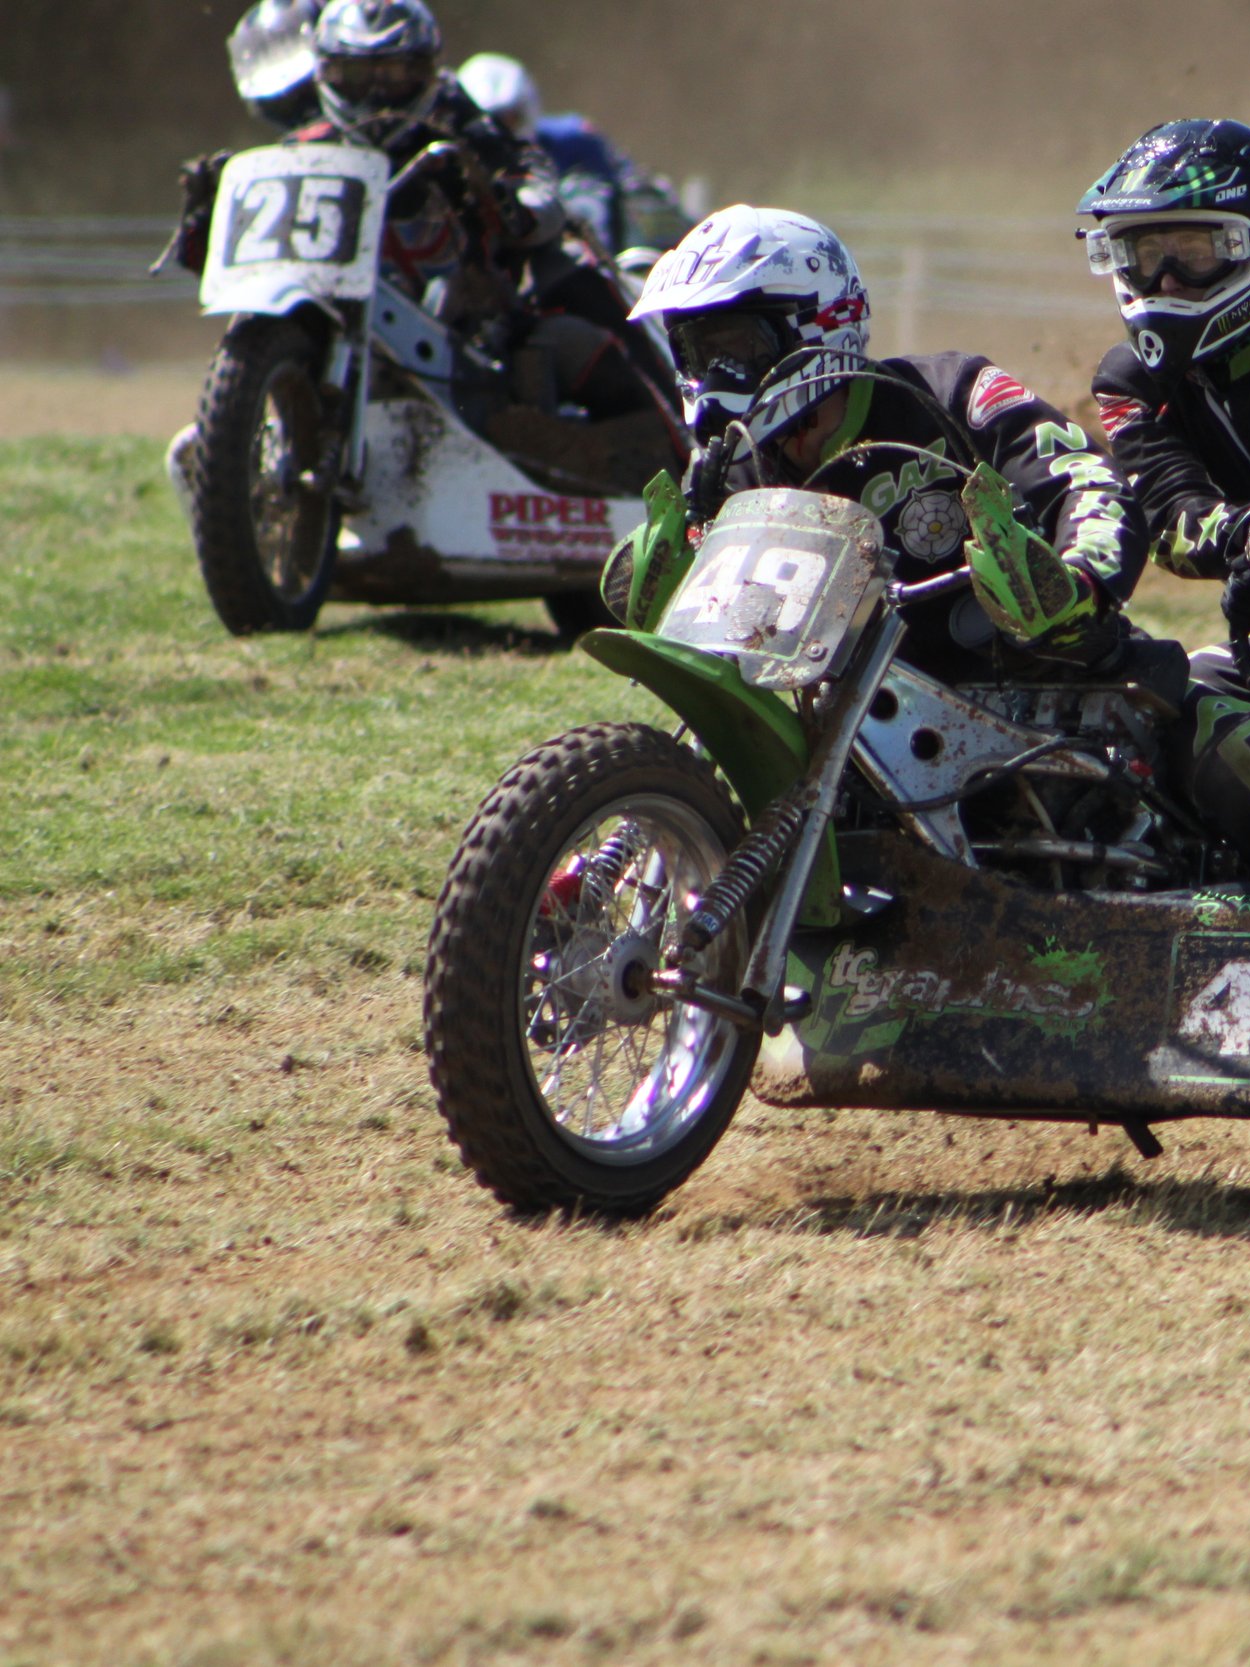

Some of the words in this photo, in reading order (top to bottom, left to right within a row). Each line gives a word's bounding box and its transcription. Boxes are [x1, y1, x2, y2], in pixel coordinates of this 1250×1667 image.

[234, 178, 344, 263] 25
[490, 494, 611, 525] PIPER
[861, 437, 957, 517] GAZ
[673, 546, 826, 630] 49
